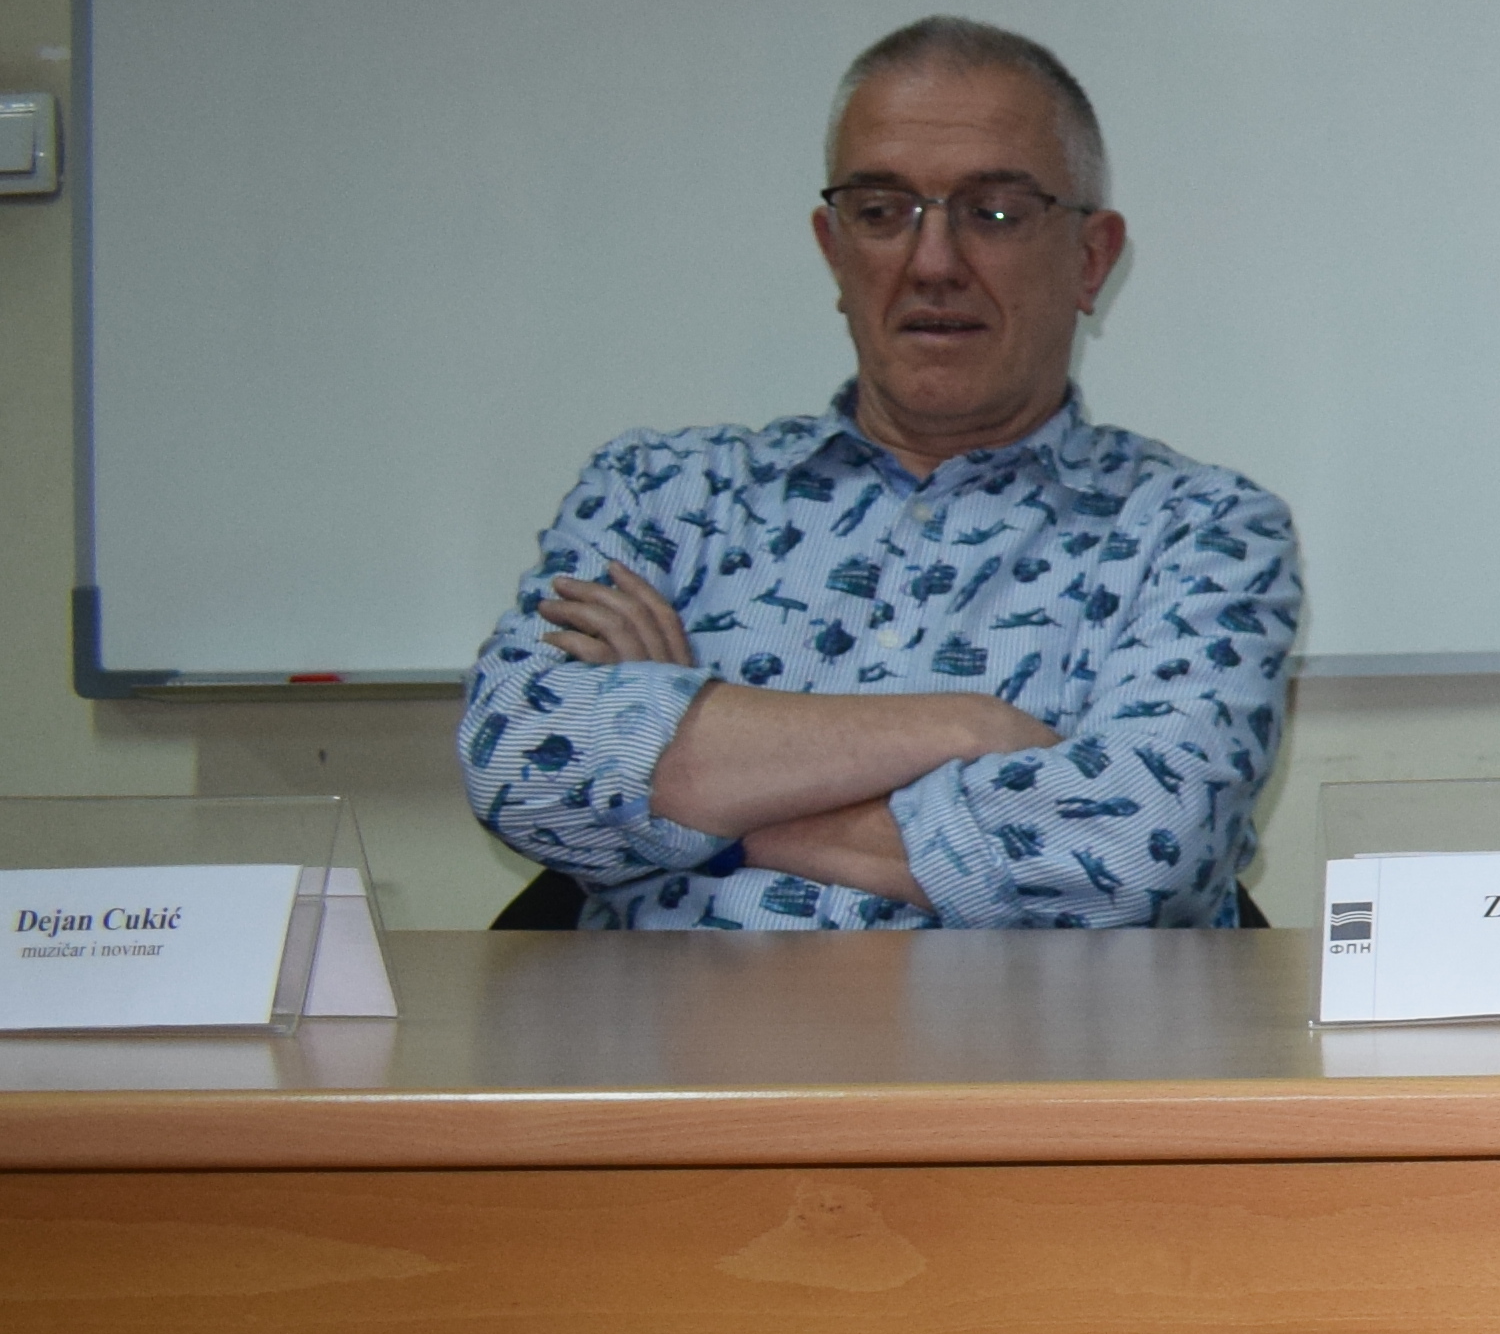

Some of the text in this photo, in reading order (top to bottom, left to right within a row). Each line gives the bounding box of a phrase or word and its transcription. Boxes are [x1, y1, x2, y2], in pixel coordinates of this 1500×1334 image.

[16, 906, 183, 938] Dejan Cukić
[21, 941, 164, 959] muzičar i novinar
[1330, 941, 1371, 954] ФПН
